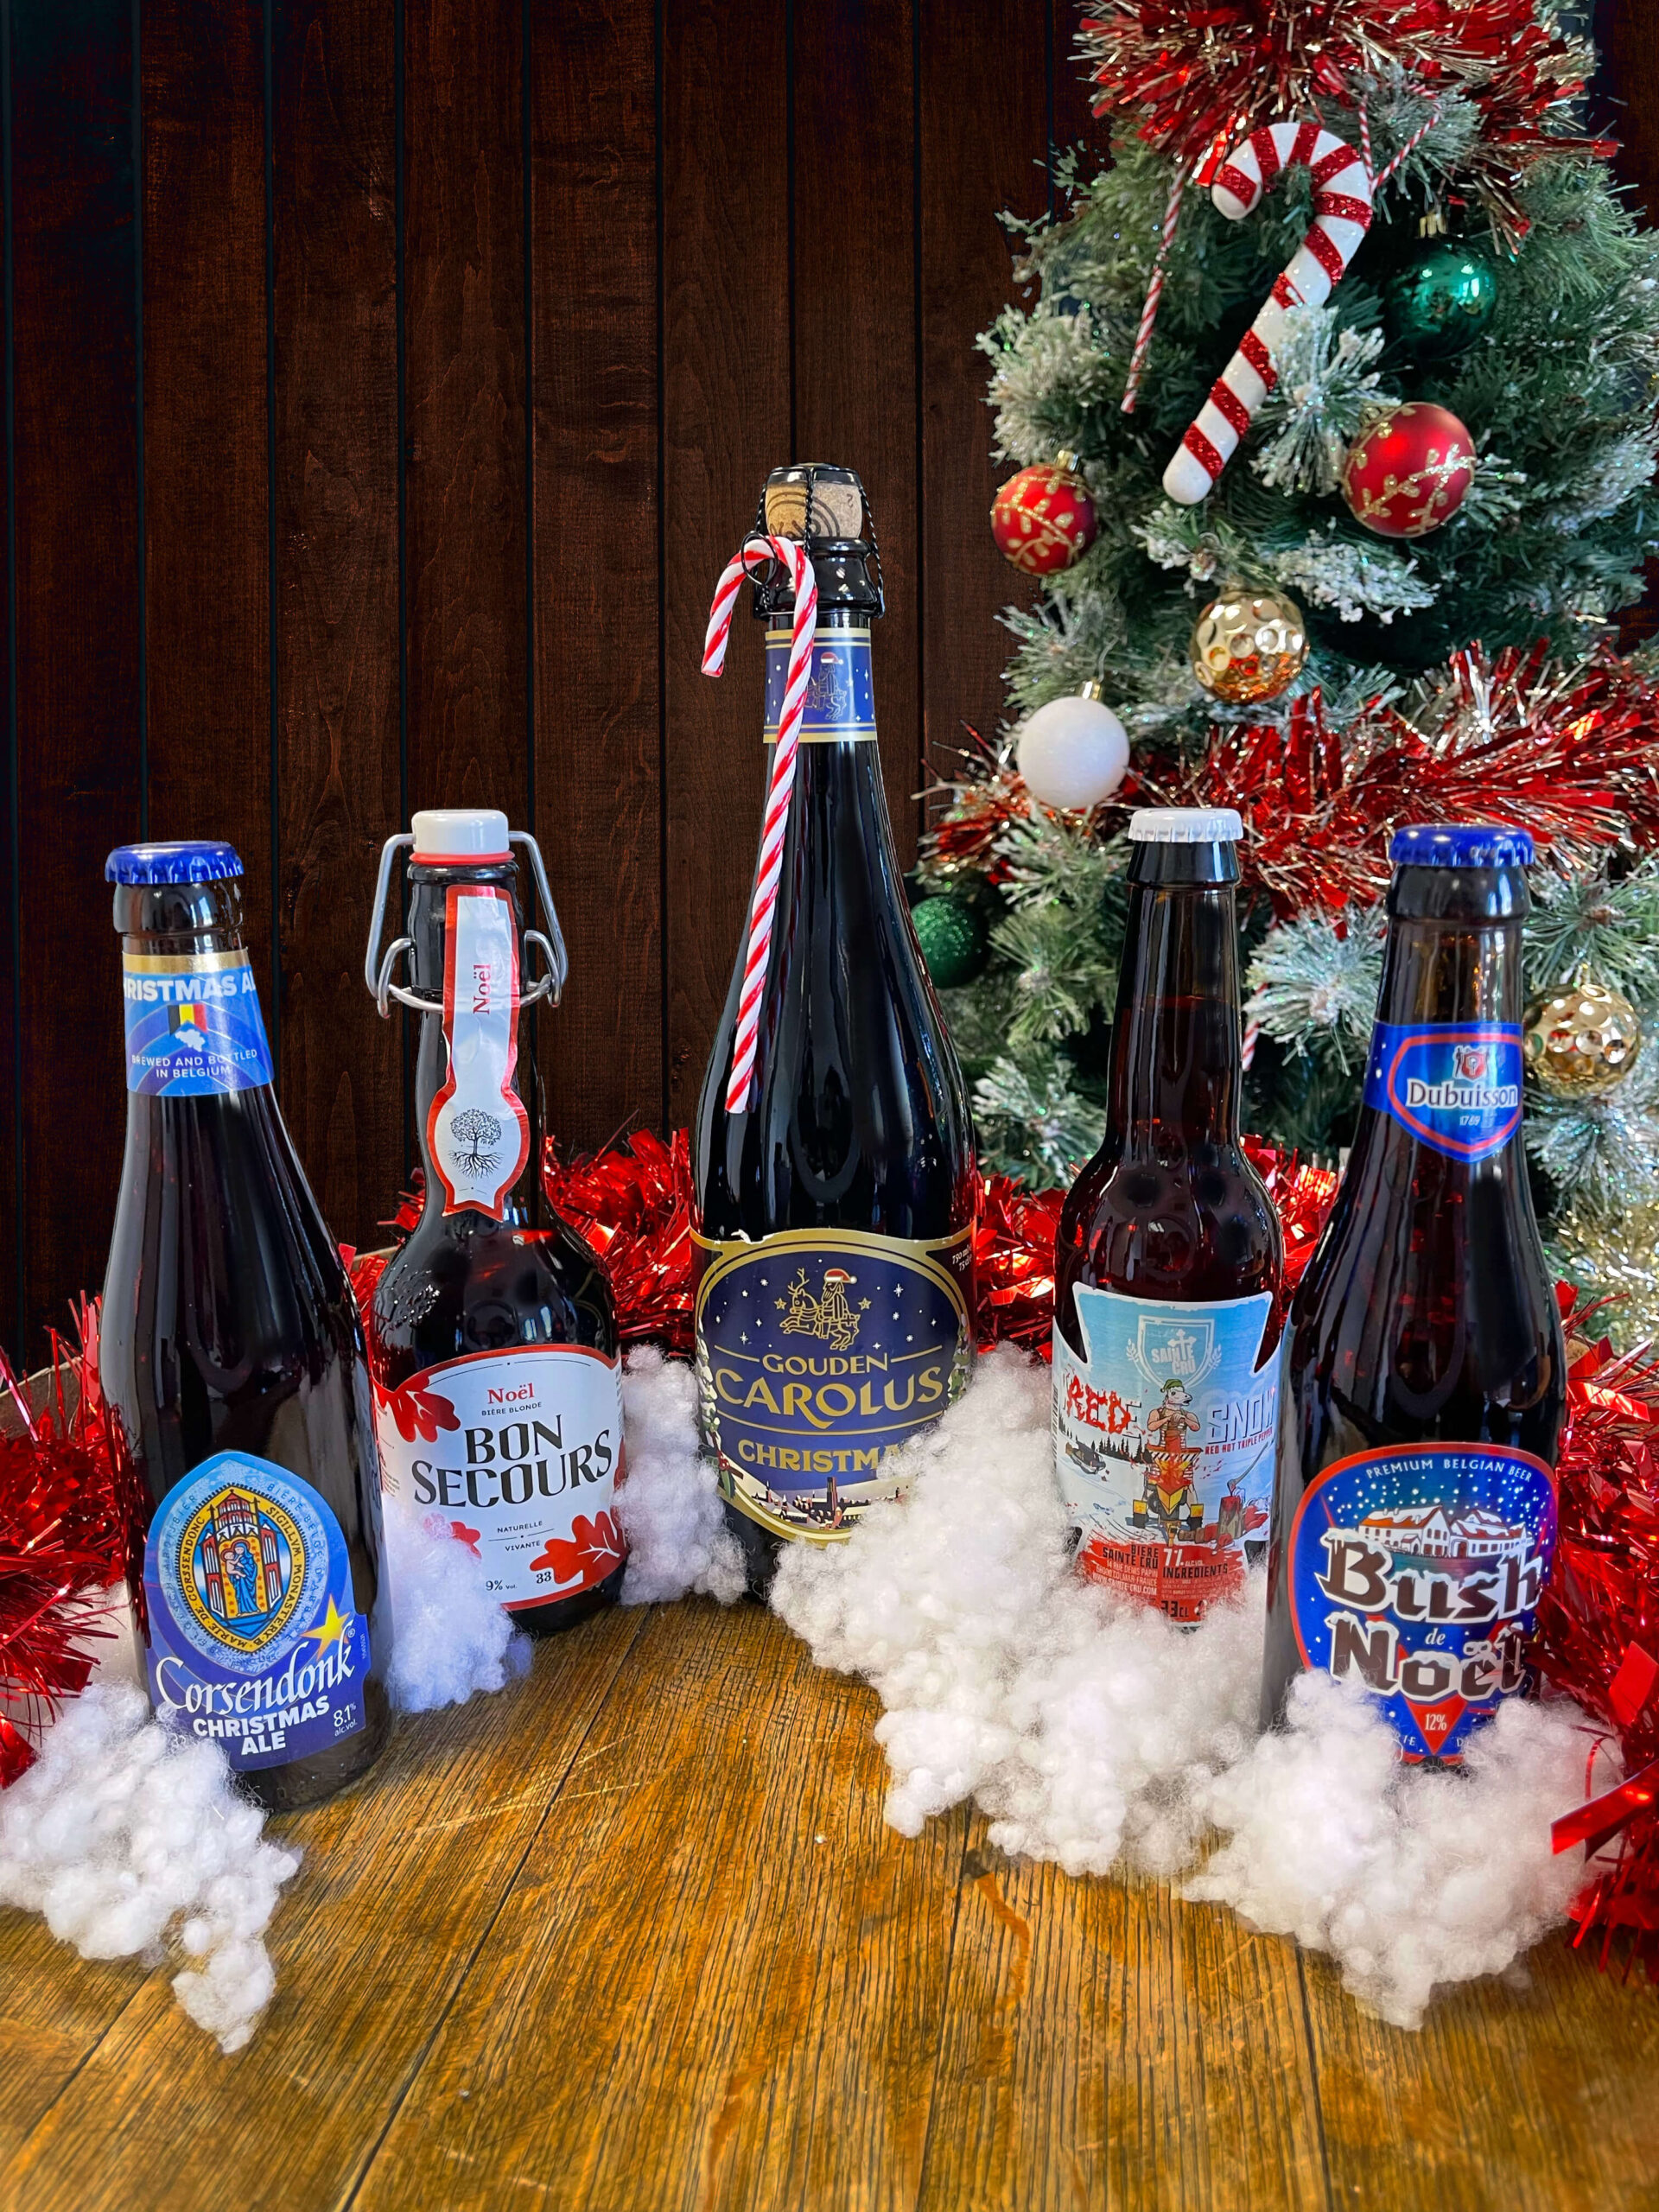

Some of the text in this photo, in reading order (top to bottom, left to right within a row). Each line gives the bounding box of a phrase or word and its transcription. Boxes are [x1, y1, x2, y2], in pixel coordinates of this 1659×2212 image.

[473, 963, 492, 1015] Noël
[131, 1048, 257, 1066] BREWED AND BOTLED
[156, 1065, 232, 1078] IN BELGIUM
[1407, 1079, 1518, 1109] Dubuisson
[1151, 1339, 1196, 1363] SAINTE
[762, 1352, 888, 1376] GOUDEN
[1172, 1359, 1196, 1376] CRU
[487, 1382, 535, 1405] Noël
[715, 1366, 944, 1430] CAROLUS
[481, 1402, 543, 1416] BIÈRE BLONDE
[464, 1414, 563, 1465] BON
[1205, 1445, 1219, 1455] RED
[1222, 1442, 1236, 1452] HOT
[1237, 1435, 1257, 1450] TRIPLE
[410, 1428, 613, 1509] SECOURS
[1366, 1459, 1532, 1483] PREMIUM BELGIAN BEER
[497, 1521, 543, 1534] NATURELLE
[505, 1541, 540, 1552] VIVANTE
[1103, 1547, 1158, 1569] SAINTE CRU
[1131, 1544, 1159, 1558] BIERE
[536, 1571, 552, 1585] 33
[1162, 1562, 1228, 1579] INGREDIENTS
[1315, 1528, 1543, 1624] Bush
[1425, 1627, 1446, 1646] de
[156, 1618, 356, 1716] Corsendonk
[1326, 1611, 1526, 1701] Noël
[193, 1694, 330, 1738] CHRISTMAS
[1425, 1713, 1447, 1731] 12%
[241, 1731, 286, 1756] ALE
